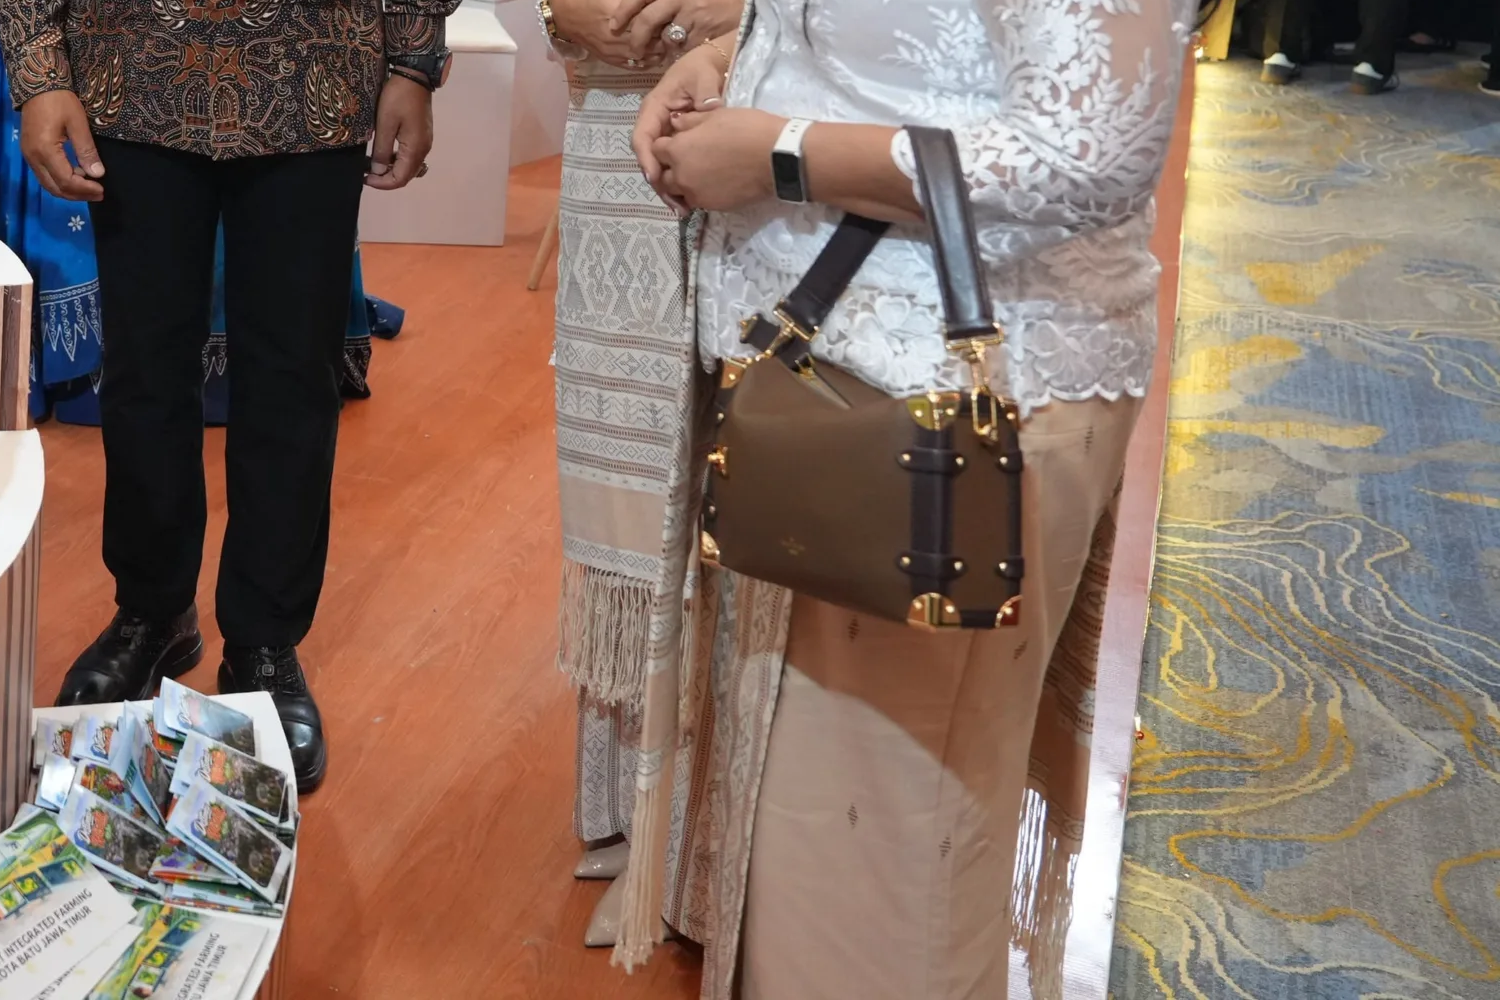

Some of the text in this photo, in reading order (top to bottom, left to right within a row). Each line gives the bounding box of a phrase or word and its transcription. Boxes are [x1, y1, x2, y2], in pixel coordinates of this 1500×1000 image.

[4, 914, 57, 958] INTEGRATED
[55, 888, 93, 921] FARMING
[18, 944, 43, 967] BATU
[43, 926, 67, 949] JAWA
[65, 905, 93, 933] TIMUR
[197, 932, 221, 968] FARMING
[199, 970, 214, 995] JAWA
[211, 944, 228, 971] TIMUR
